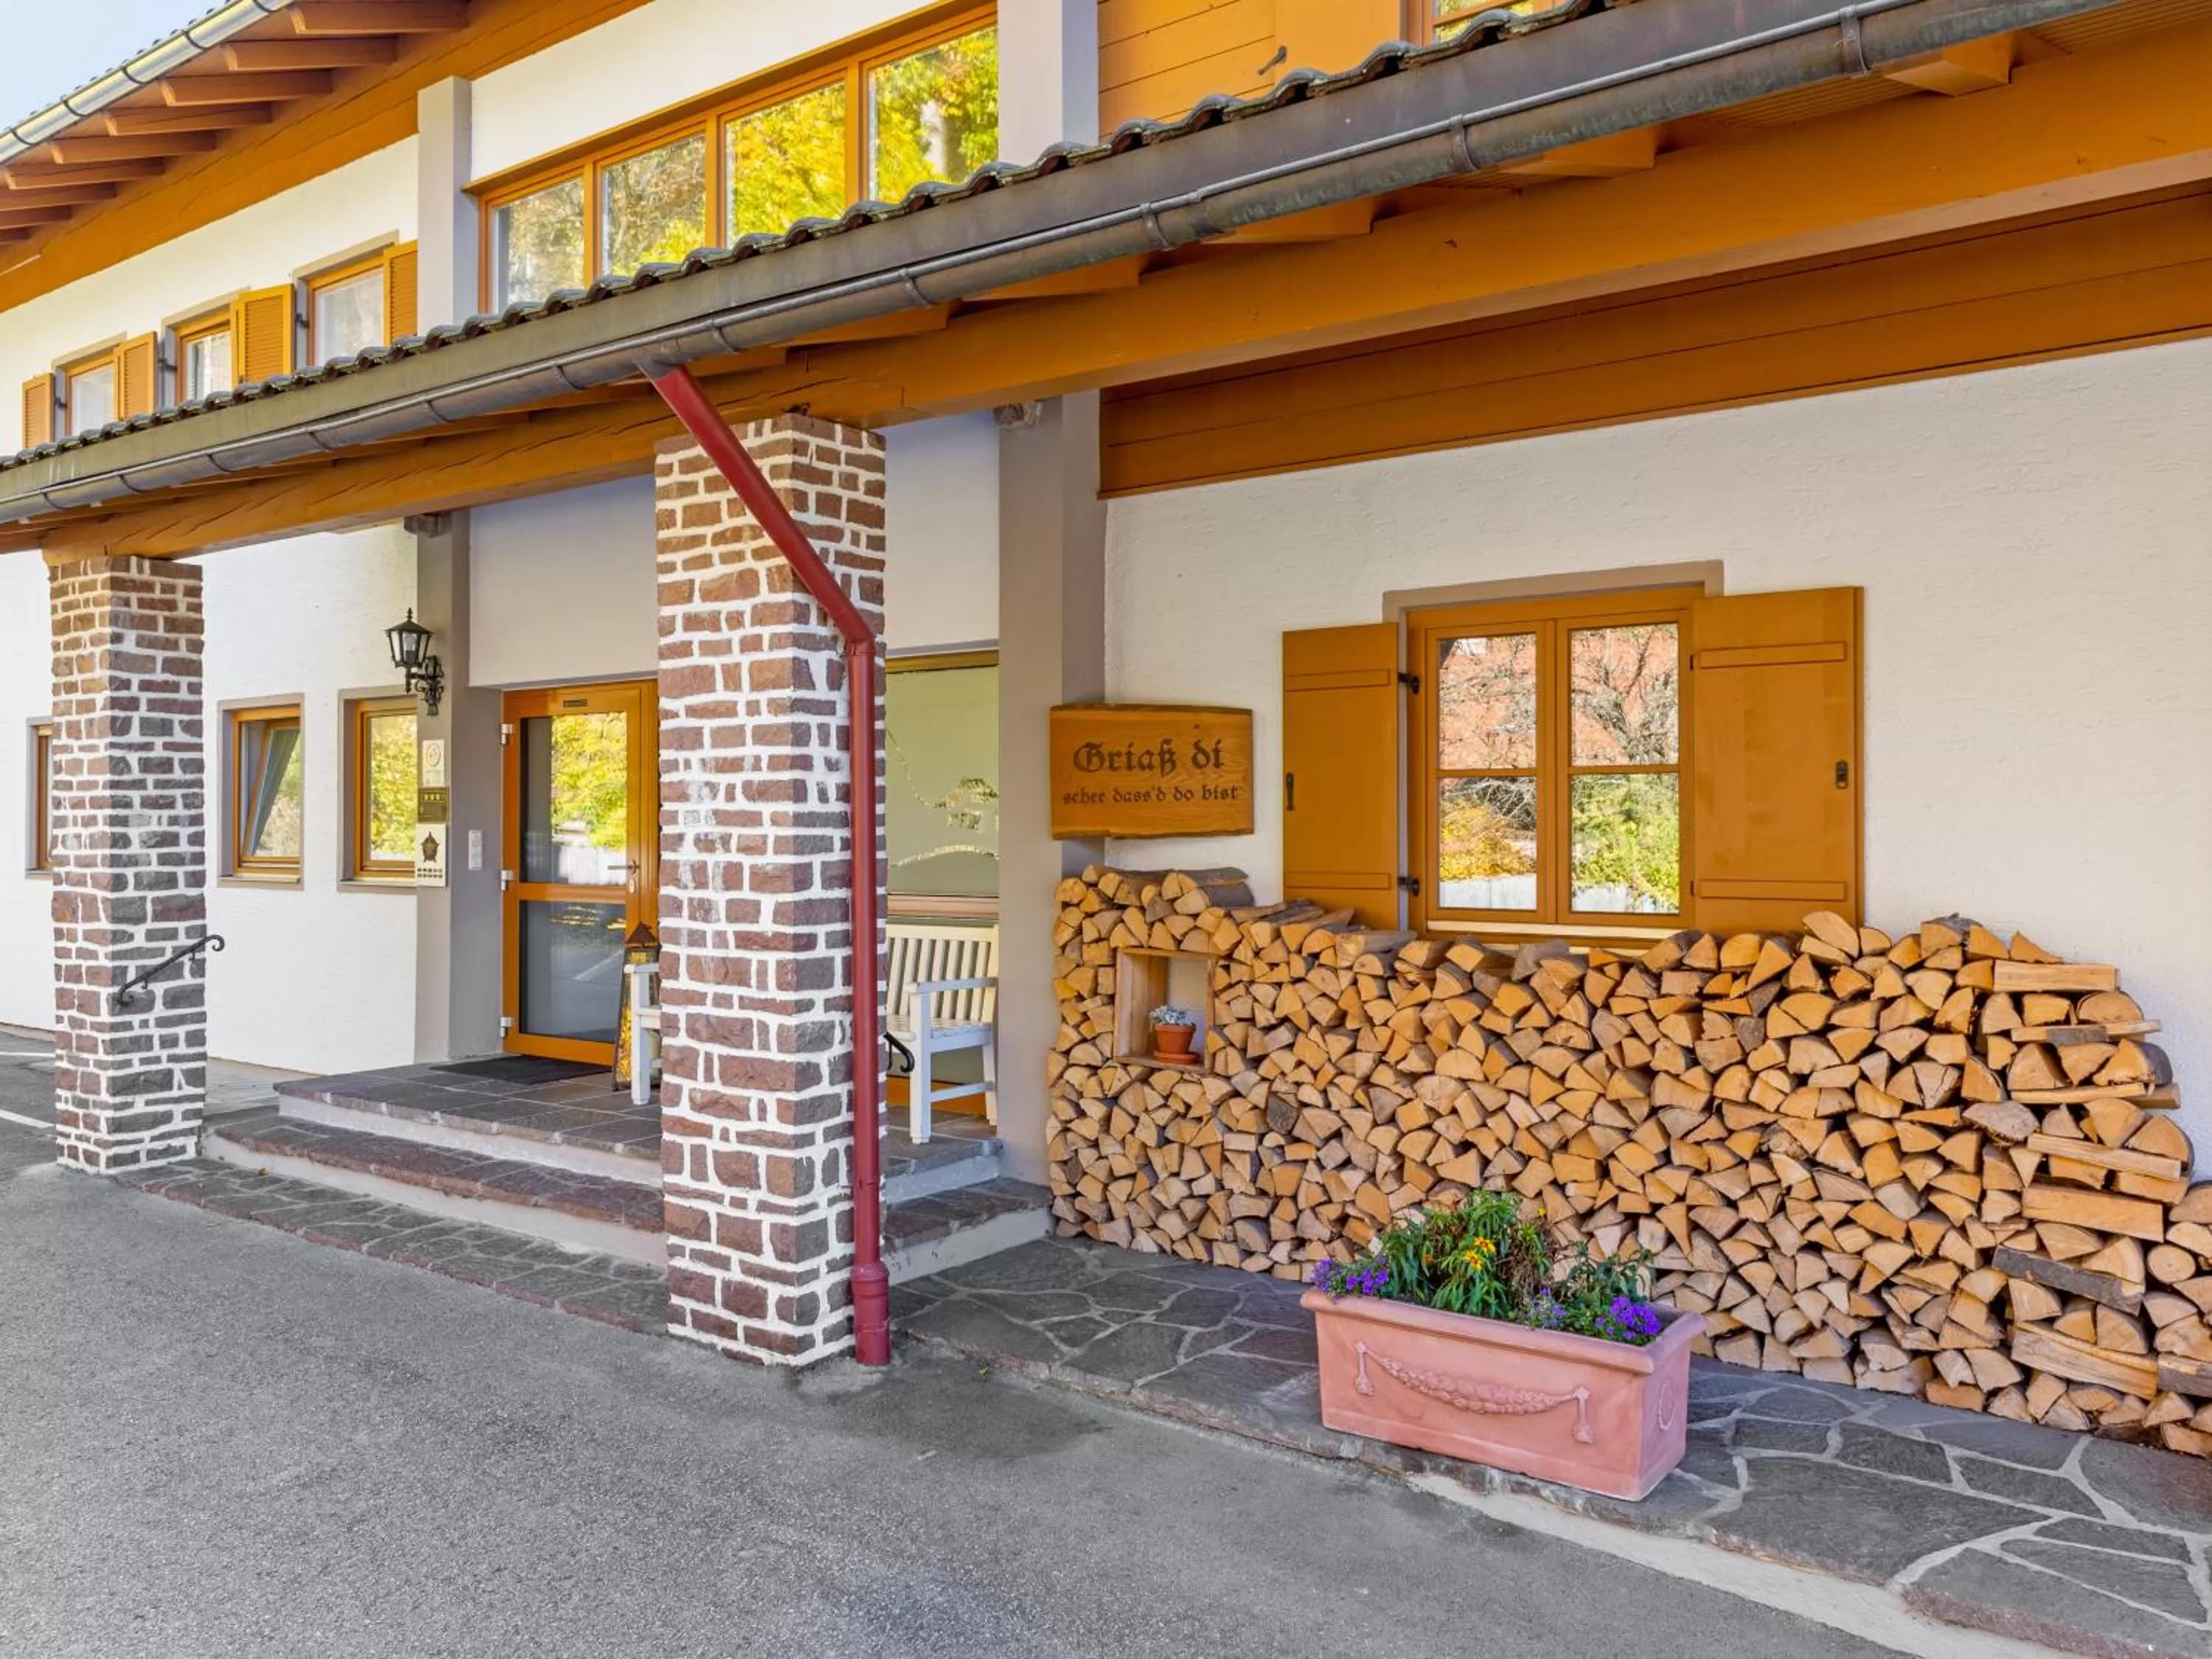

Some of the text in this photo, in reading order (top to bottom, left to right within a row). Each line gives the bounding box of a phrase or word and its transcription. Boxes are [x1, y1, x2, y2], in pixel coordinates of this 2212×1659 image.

[1073, 739, 1225, 777] Griaß di
[1173, 784, 1194, 801] do
[1202, 784, 1239, 801] bist
